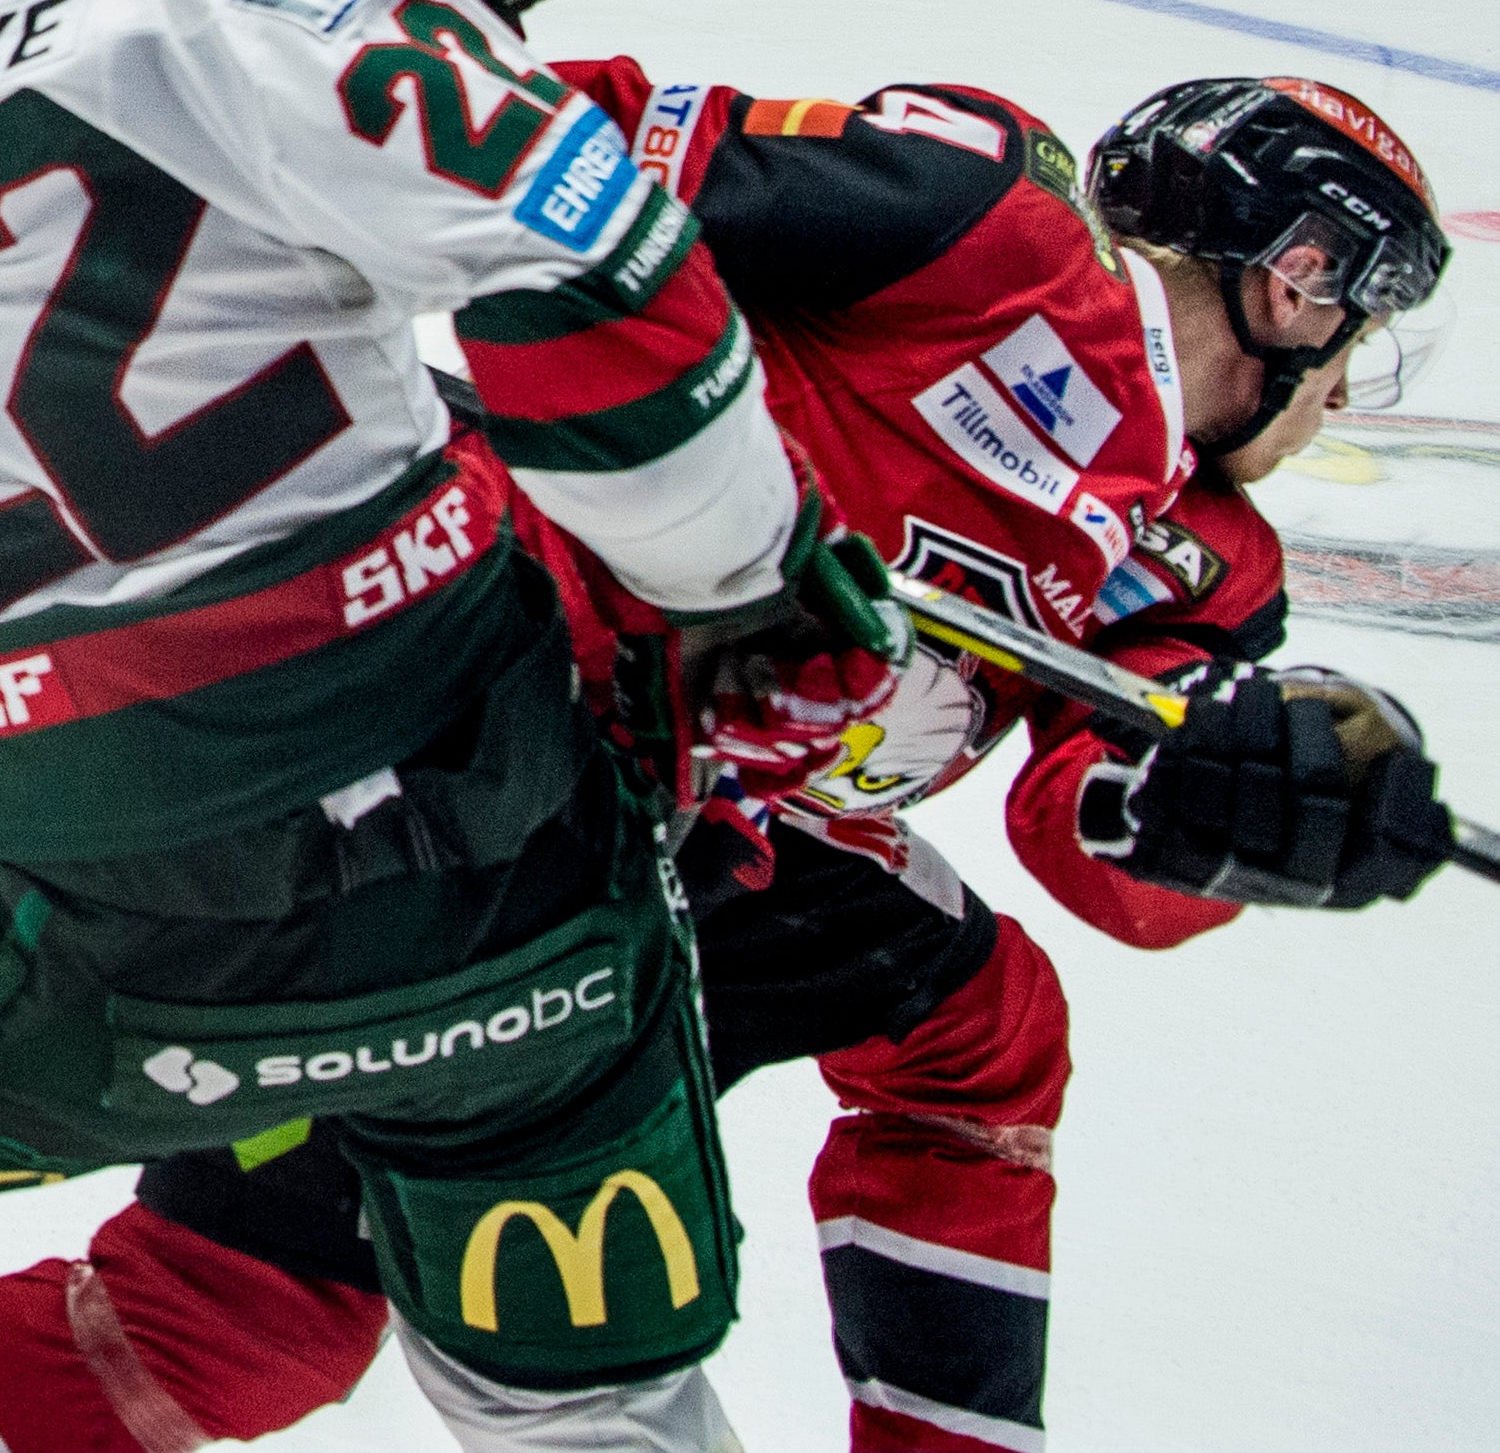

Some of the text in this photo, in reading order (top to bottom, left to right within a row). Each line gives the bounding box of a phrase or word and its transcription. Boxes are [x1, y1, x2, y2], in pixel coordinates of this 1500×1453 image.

[1318, 180, 1392, 232] CCM
[940, 381, 1061, 497] Tillmobil
[339, 489, 474, 628] SKF
[1033, 563, 1096, 640] MAL
